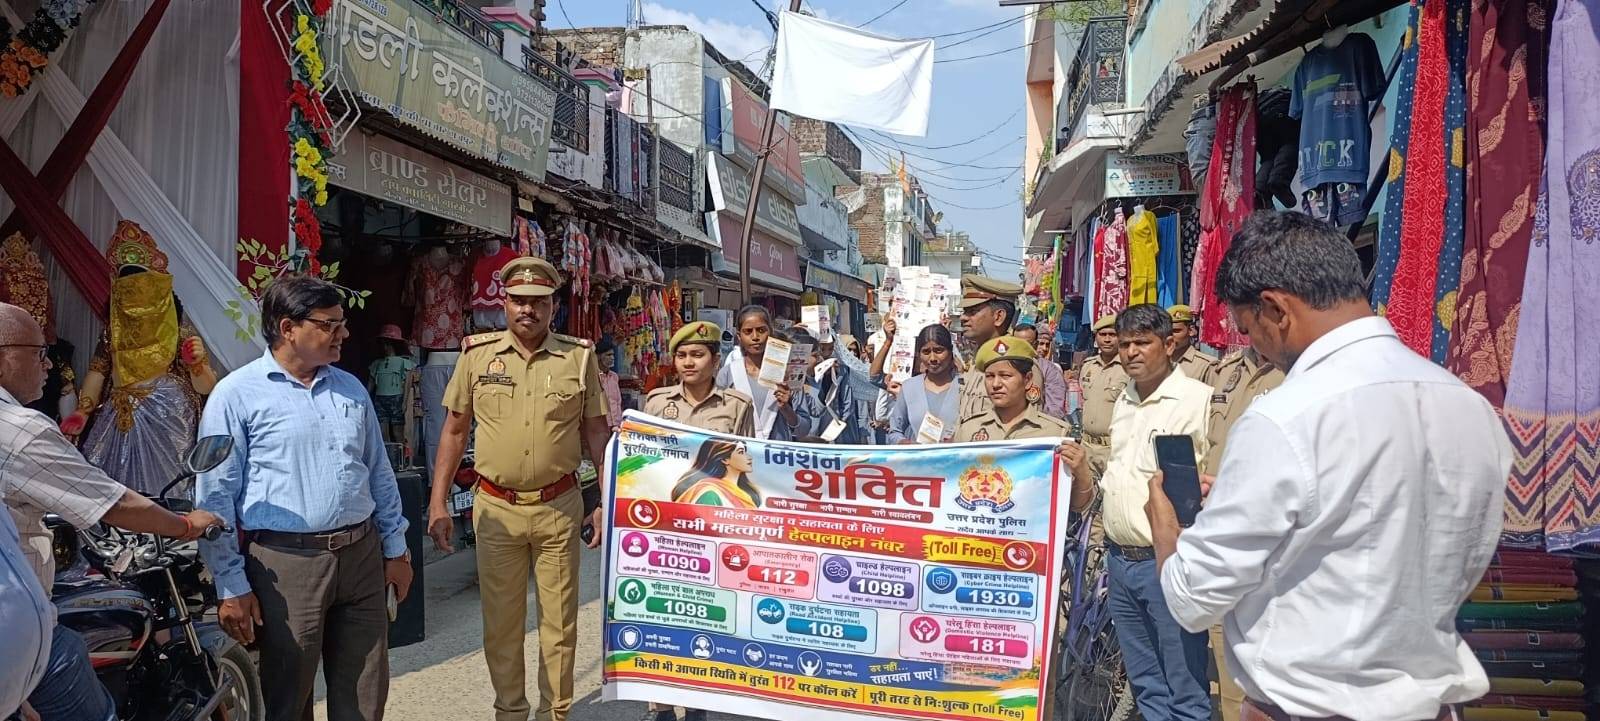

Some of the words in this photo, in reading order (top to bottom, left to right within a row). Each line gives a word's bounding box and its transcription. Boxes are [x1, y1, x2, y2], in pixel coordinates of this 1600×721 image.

[433, 50, 548, 146] कलेक्शन्स
[660, 434, 678, 445] नारी
[623, 443, 657, 456] सुरक्षित
[660, 448, 689, 459] समाज
[764, 444, 842, 470] मिशन
[794, 463, 945, 508] शक्ति
[774, 499, 787, 508] नारी
[820, 504, 833, 513] नारी
[872, 508, 886, 517] नारी
[946, 513, 968, 522] उत्तर
[971, 514, 995, 525] प्रदेश
[998, 516, 1026, 528] पुलिस
[714, 509, 749, 520] महिला
[752, 513, 783, 525] सुरक्षा
[799, 519, 843, 531] सहायता
[847, 521, 857, 532] के
[861, 523, 885, 535] लिए
[654, 536, 674, 545] महिला
[676, 538, 706, 550] हेल्पलाइन
[673, 518, 705, 531] सभी
[711, 521, 784, 540] महत्वपूर्ण
[788, 527, 865, 548] हेल्पलाइन
[870, 536, 904, 552] नंबर
[753, 550, 798, 561] आपातकालीन
[800, 553, 814, 563] सेवा
[929, 541, 960, 556] (Toll
[962, 544, 996, 562] Free)
[657, 553, 700, 571] 1090
[880, 562, 911, 574] हेल्पलाइन
[761, 568, 796, 585] 112
[961, 572, 982, 580] साइबर
[984, 573, 1001, 581] क्राइम
[1003, 573, 1034, 584] हेल्पलाइन
[651, 582, 670, 591] महिला
[671, 583, 681, 593] एवं
[695, 589, 716, 598] अपराध
[856, 579, 905, 597] 1098
[969, 590, 1020, 606] 1930
[664, 600, 708, 618] 1098
[808, 605, 832, 616] दुर्घटना
[833, 609, 860, 619] सहायता
[808, 621, 844, 638] 108
[945, 619, 964, 629] घरेलू
[964, 619, 981, 629] हिंसा
[983, 620, 1016, 632] हेल्पलाइन
[976, 629, 1001, 637] Violence
[969, 638, 1005, 654] 181
[869, 663, 882, 672] डर
[634, 657, 660, 670] किसी
[662, 660, 673, 672] भी
[675, 663, 707, 677] आपात
[709, 666, 736, 680] स्थिति
[739, 671, 747, 683] में
[750, 674, 769, 687] तुरंत
[773, 675, 796, 691] 112
[798, 682, 812, 693] पर
[814, 683, 838, 697] कॉल
[841, 687, 858, 699] करें
[869, 671, 911, 685] सहायता
[913, 667, 938, 681] पाएं!
[870, 691, 887, 704] पूरी
[889, 693, 910, 705] तरह
[913, 694, 922, 706] से
[924, 695, 969, 713] निःशुल्क
[972, 703, 997, 716] (Toll
[998, 705, 1025, 720] Free)
